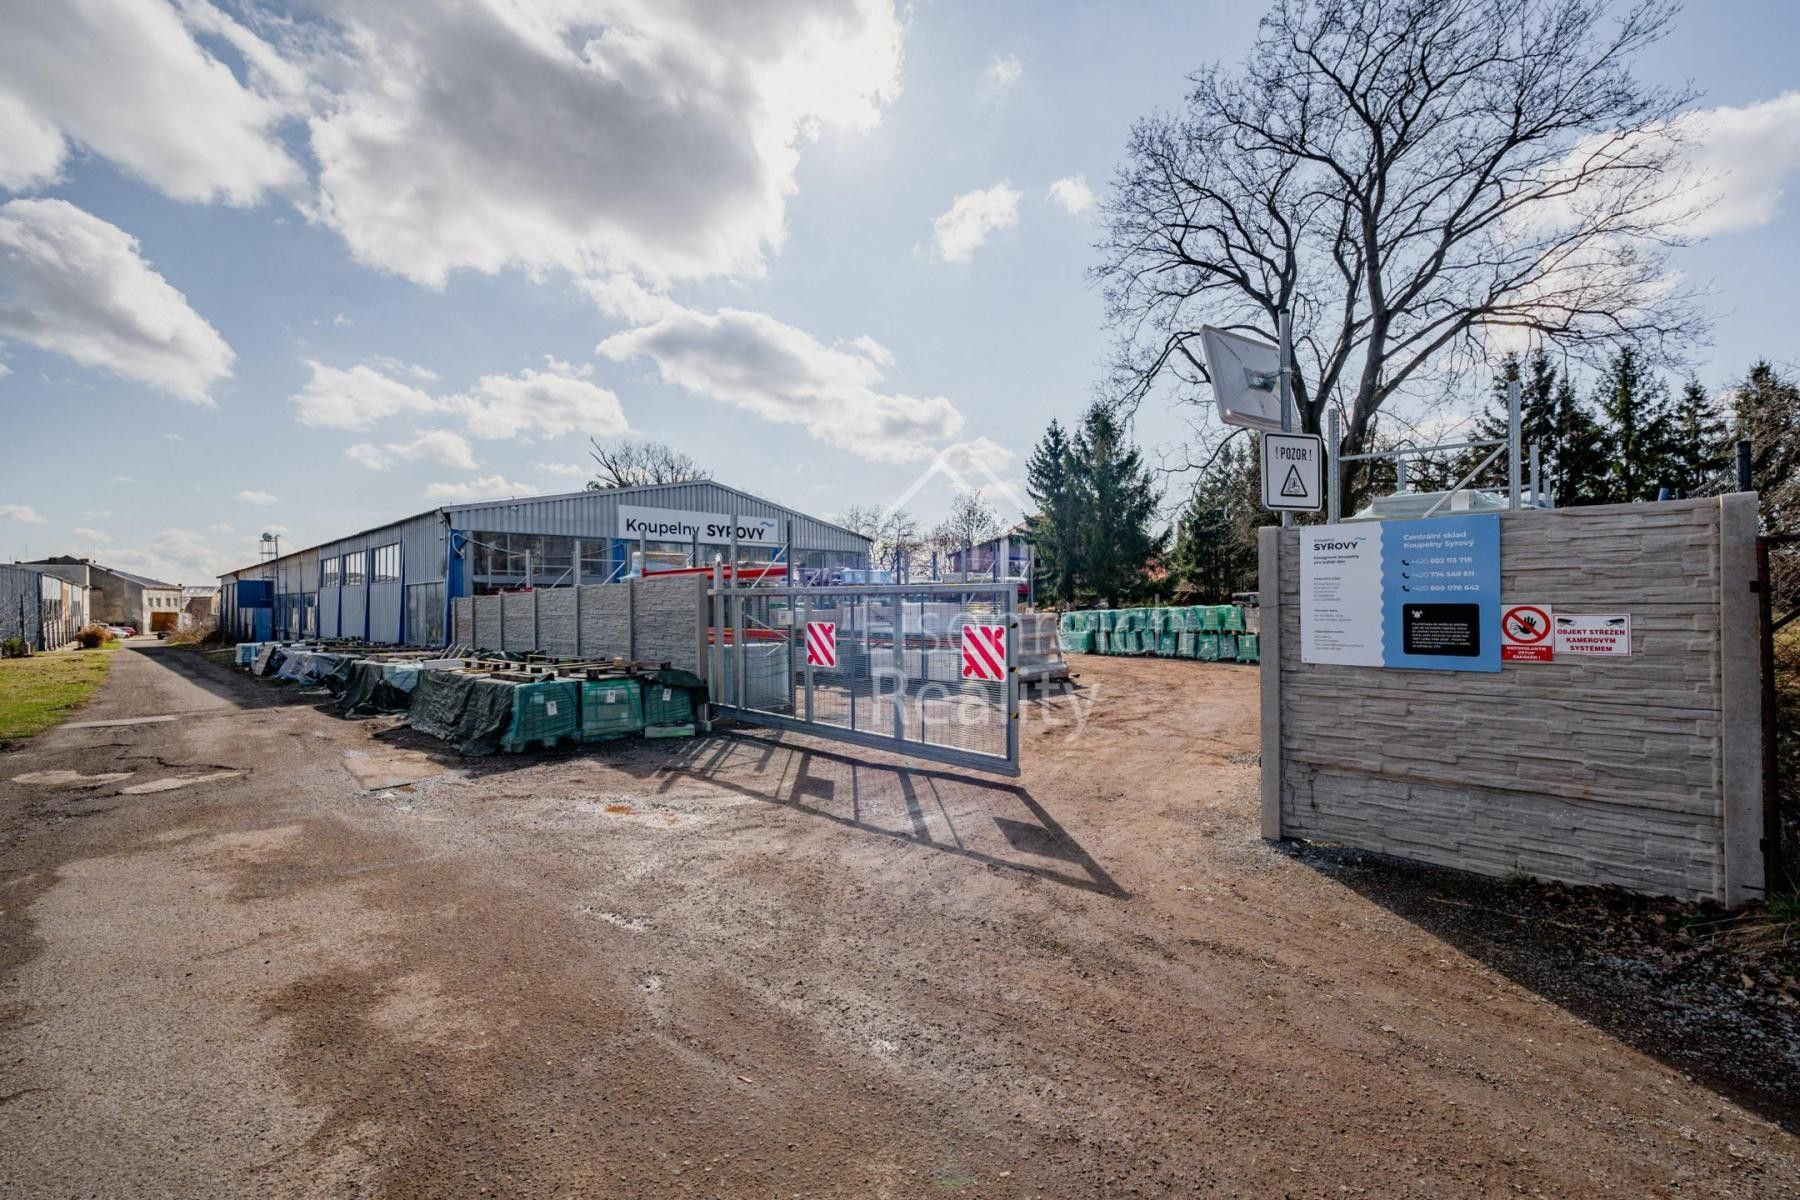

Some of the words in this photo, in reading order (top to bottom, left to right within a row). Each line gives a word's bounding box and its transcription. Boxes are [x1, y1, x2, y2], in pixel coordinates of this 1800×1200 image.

[1443, 531, 1467, 539] sklad
[1313, 541, 1358, 551] SYROVY
[1403, 541, 1442, 549] Koupelny
